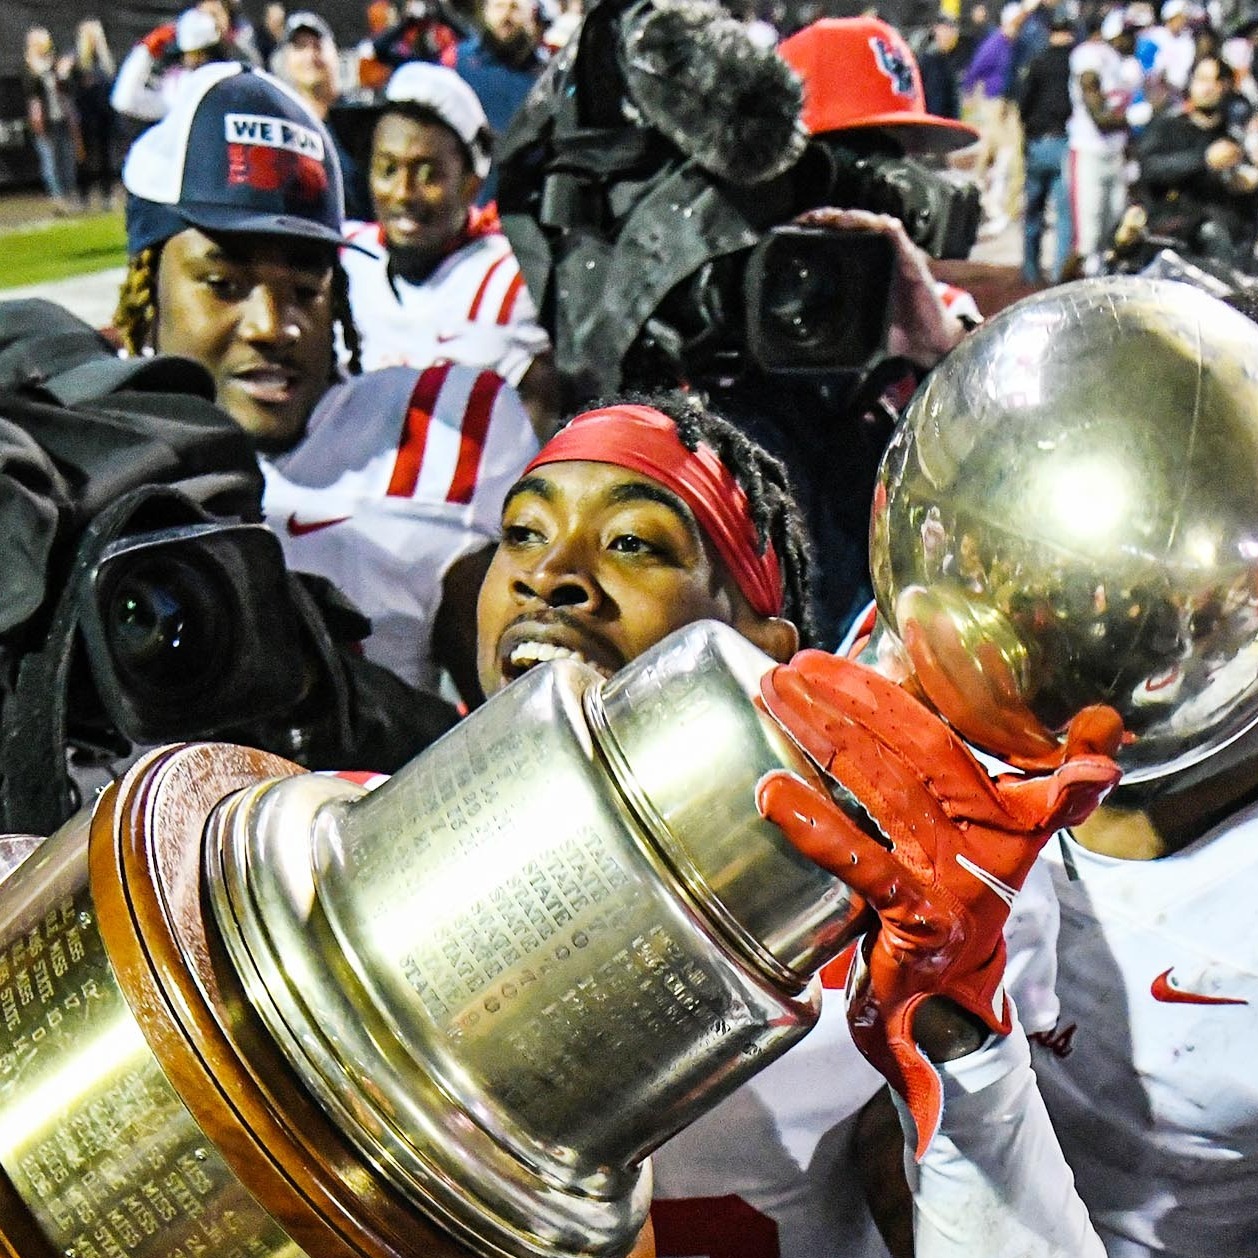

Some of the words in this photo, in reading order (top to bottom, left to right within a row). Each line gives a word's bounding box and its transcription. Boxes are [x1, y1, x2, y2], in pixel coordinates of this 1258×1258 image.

[233, 121, 273, 141] WE
[520, 860, 572, 928] STATE
[538, 846, 590, 913] STATE
[504, 874, 556, 942] STATE
[32, 958, 55, 1004] STATE
[430, 924, 485, 994] STATE
[122, 1191, 159, 1236] MISS
[140, 1177, 178, 1223] MISS
[105, 1204, 143, 1249] MISS
